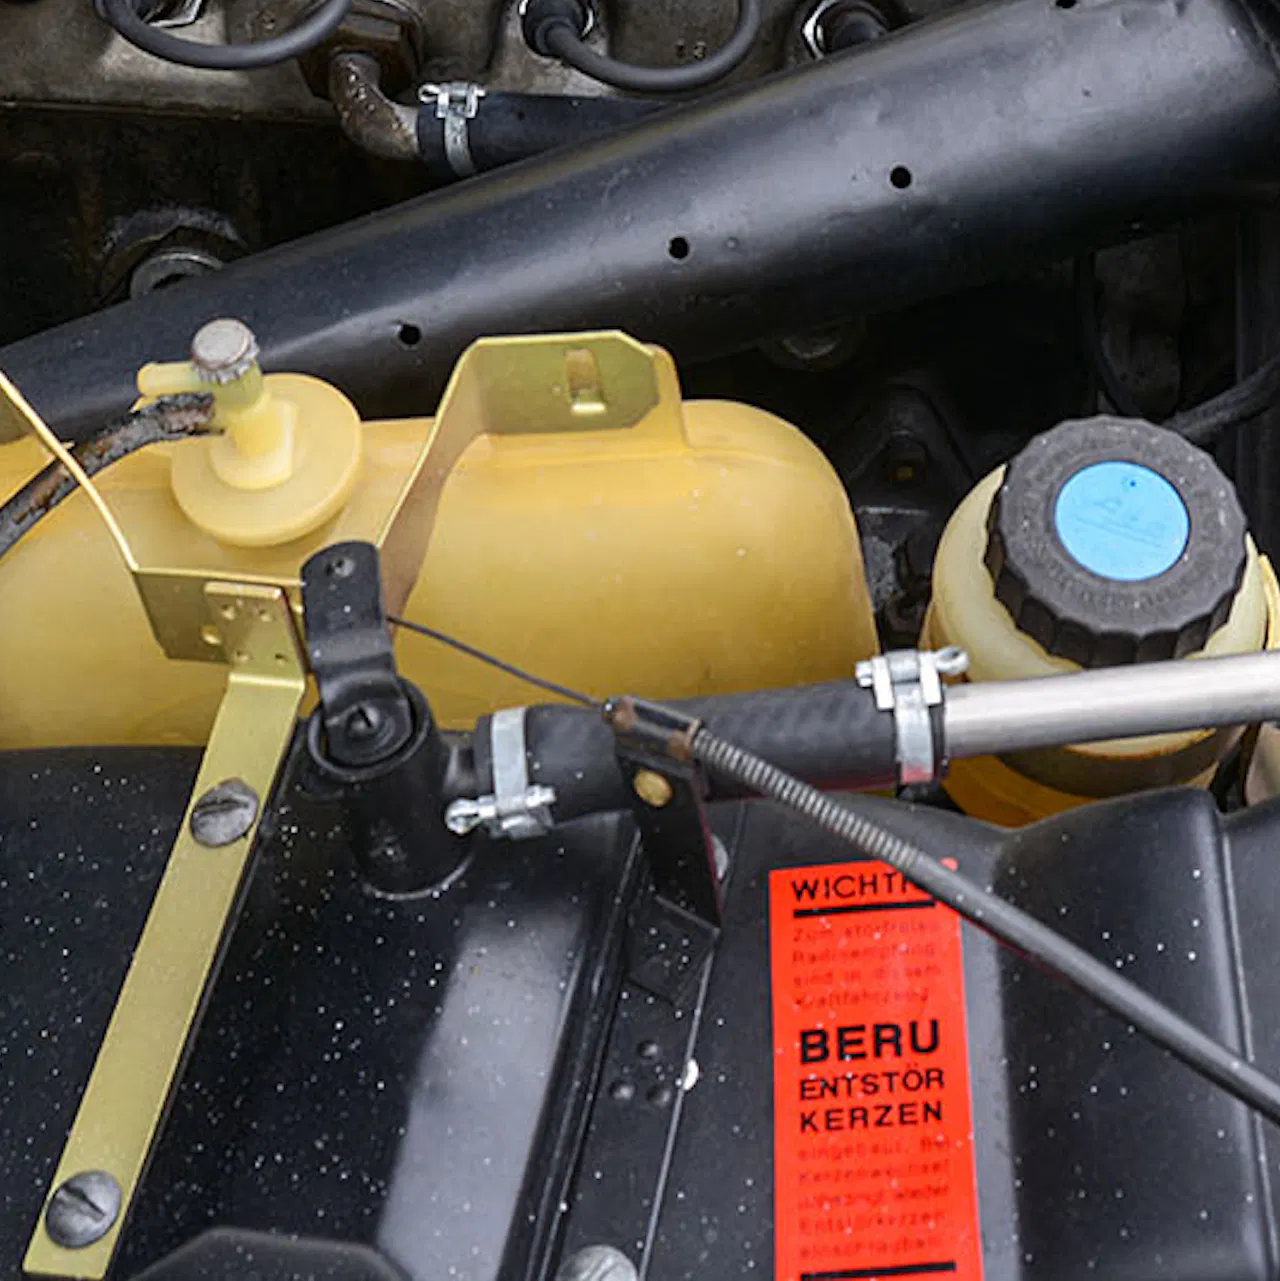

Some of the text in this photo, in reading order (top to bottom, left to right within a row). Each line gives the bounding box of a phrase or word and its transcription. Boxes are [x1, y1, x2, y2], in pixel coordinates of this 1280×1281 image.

[792, 871, 908, 903] WICHTI
[800, 1019, 939, 1065] BERU
[800, 1062, 945, 1100] ENTSTÖR
[801, 1101, 943, 1132] KERZEN
